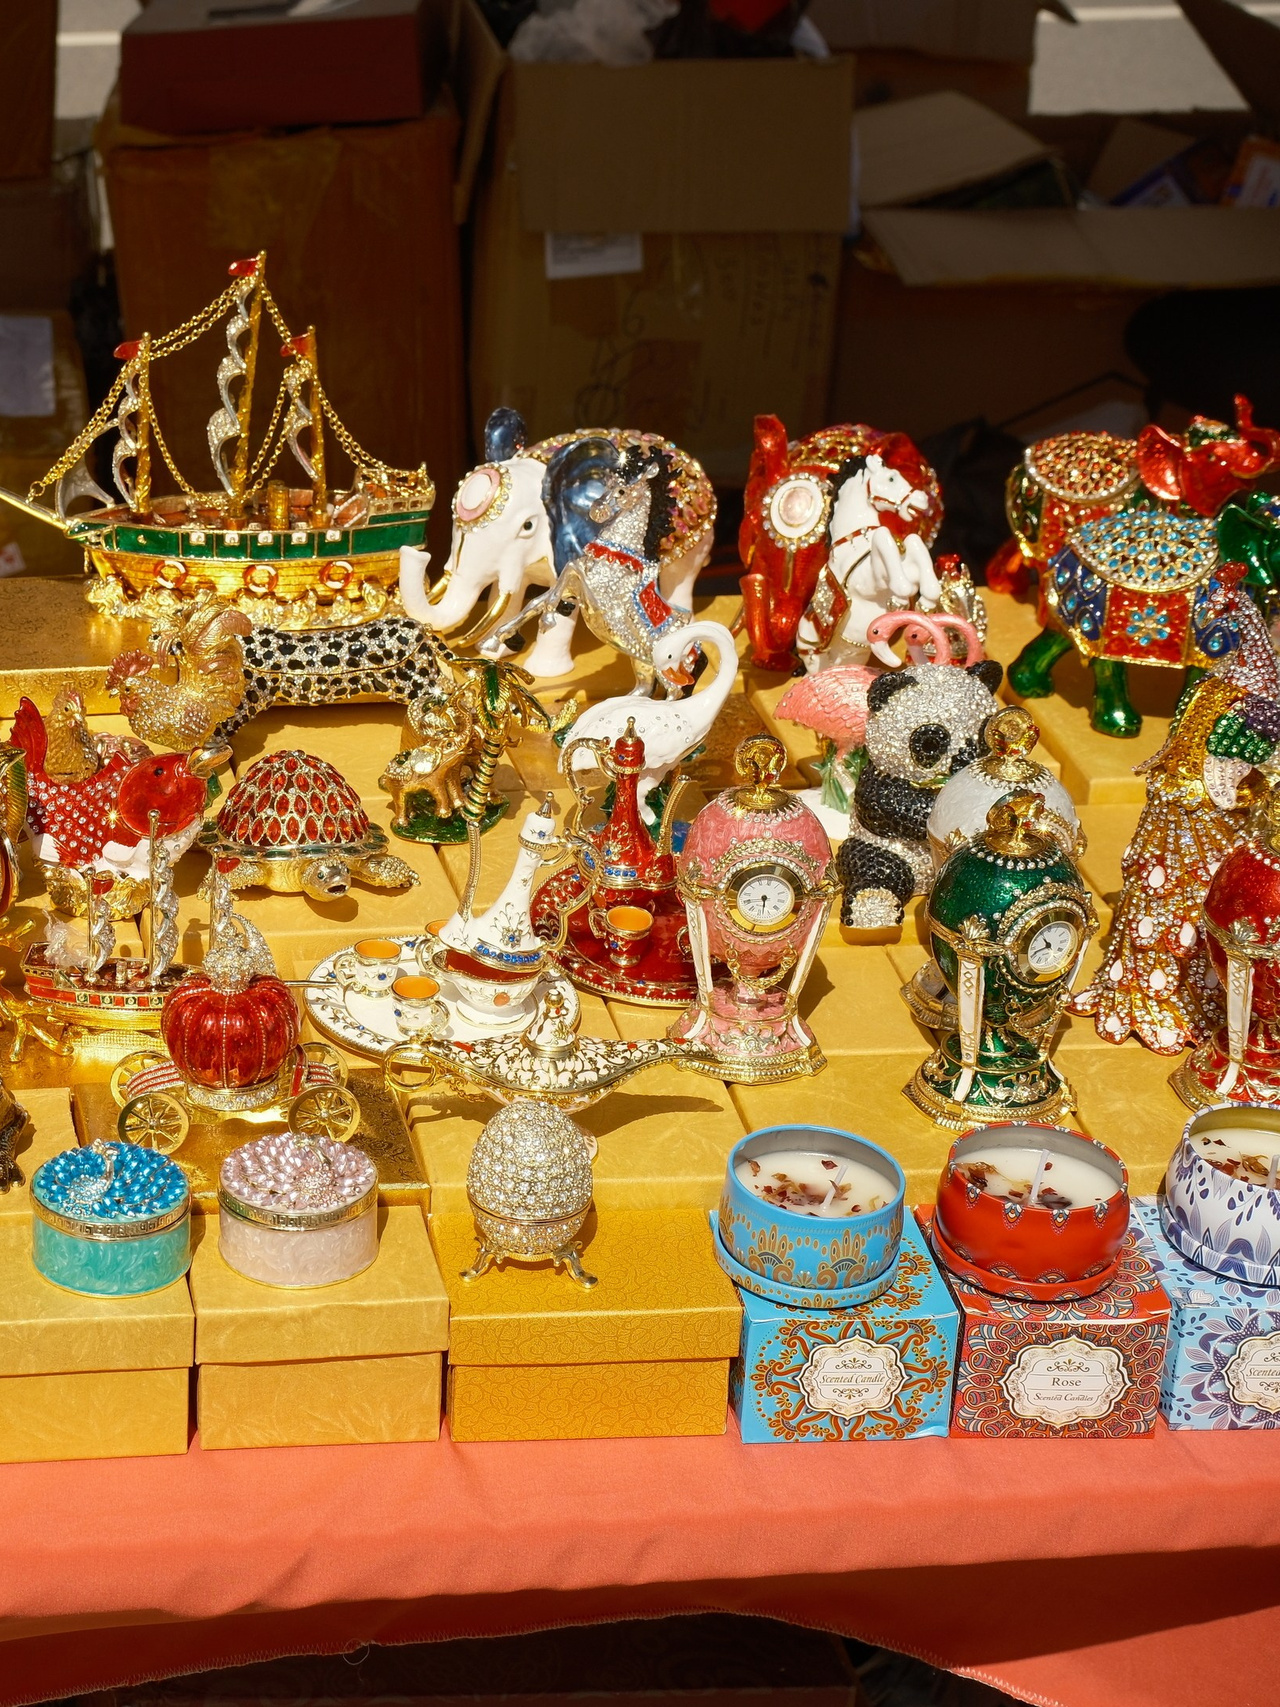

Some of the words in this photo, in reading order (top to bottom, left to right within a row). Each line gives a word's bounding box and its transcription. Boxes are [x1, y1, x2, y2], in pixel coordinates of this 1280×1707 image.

[819, 1374, 853, 1384] Scented
[855, 1372, 885, 1384] Candle
[1051, 1377, 1082, 1387] Rose
[1033, 1392, 1062, 1402] Scented
[1064, 1393, 1094, 1402] Candles
